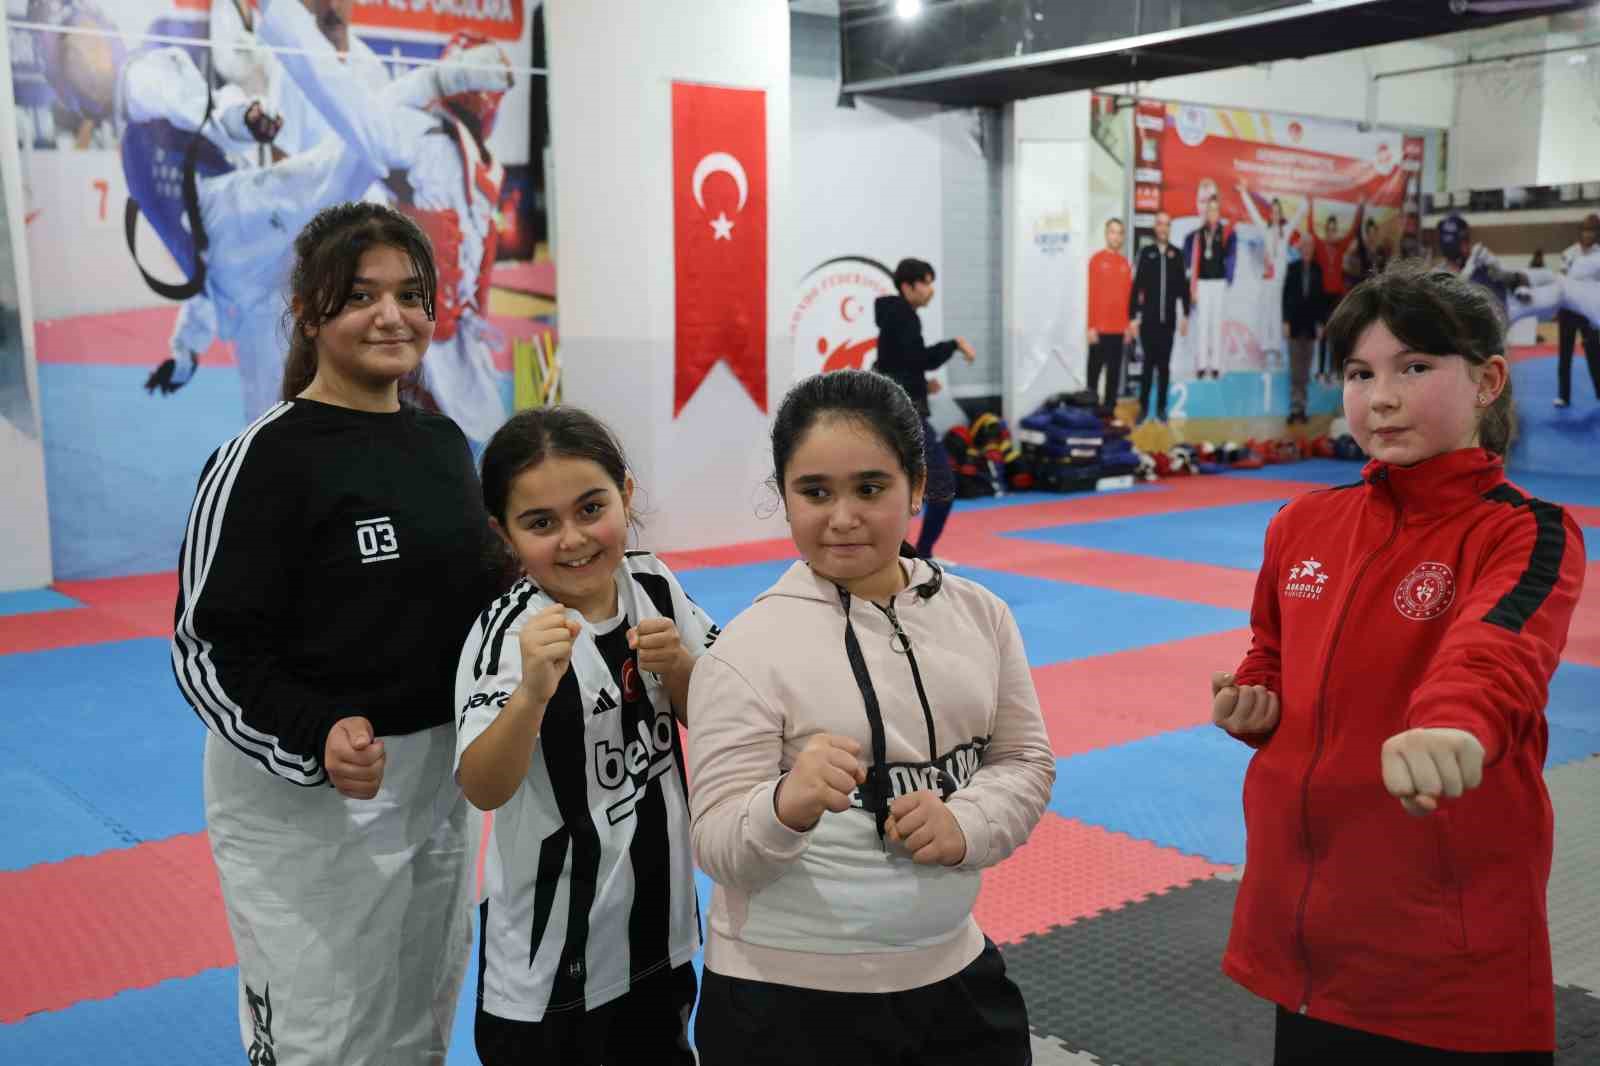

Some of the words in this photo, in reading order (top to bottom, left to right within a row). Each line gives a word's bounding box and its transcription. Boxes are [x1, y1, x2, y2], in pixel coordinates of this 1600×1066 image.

[1168, 384, 1187, 417] 2
[357, 523, 398, 556] 03
[887, 764, 944, 804] OVE
